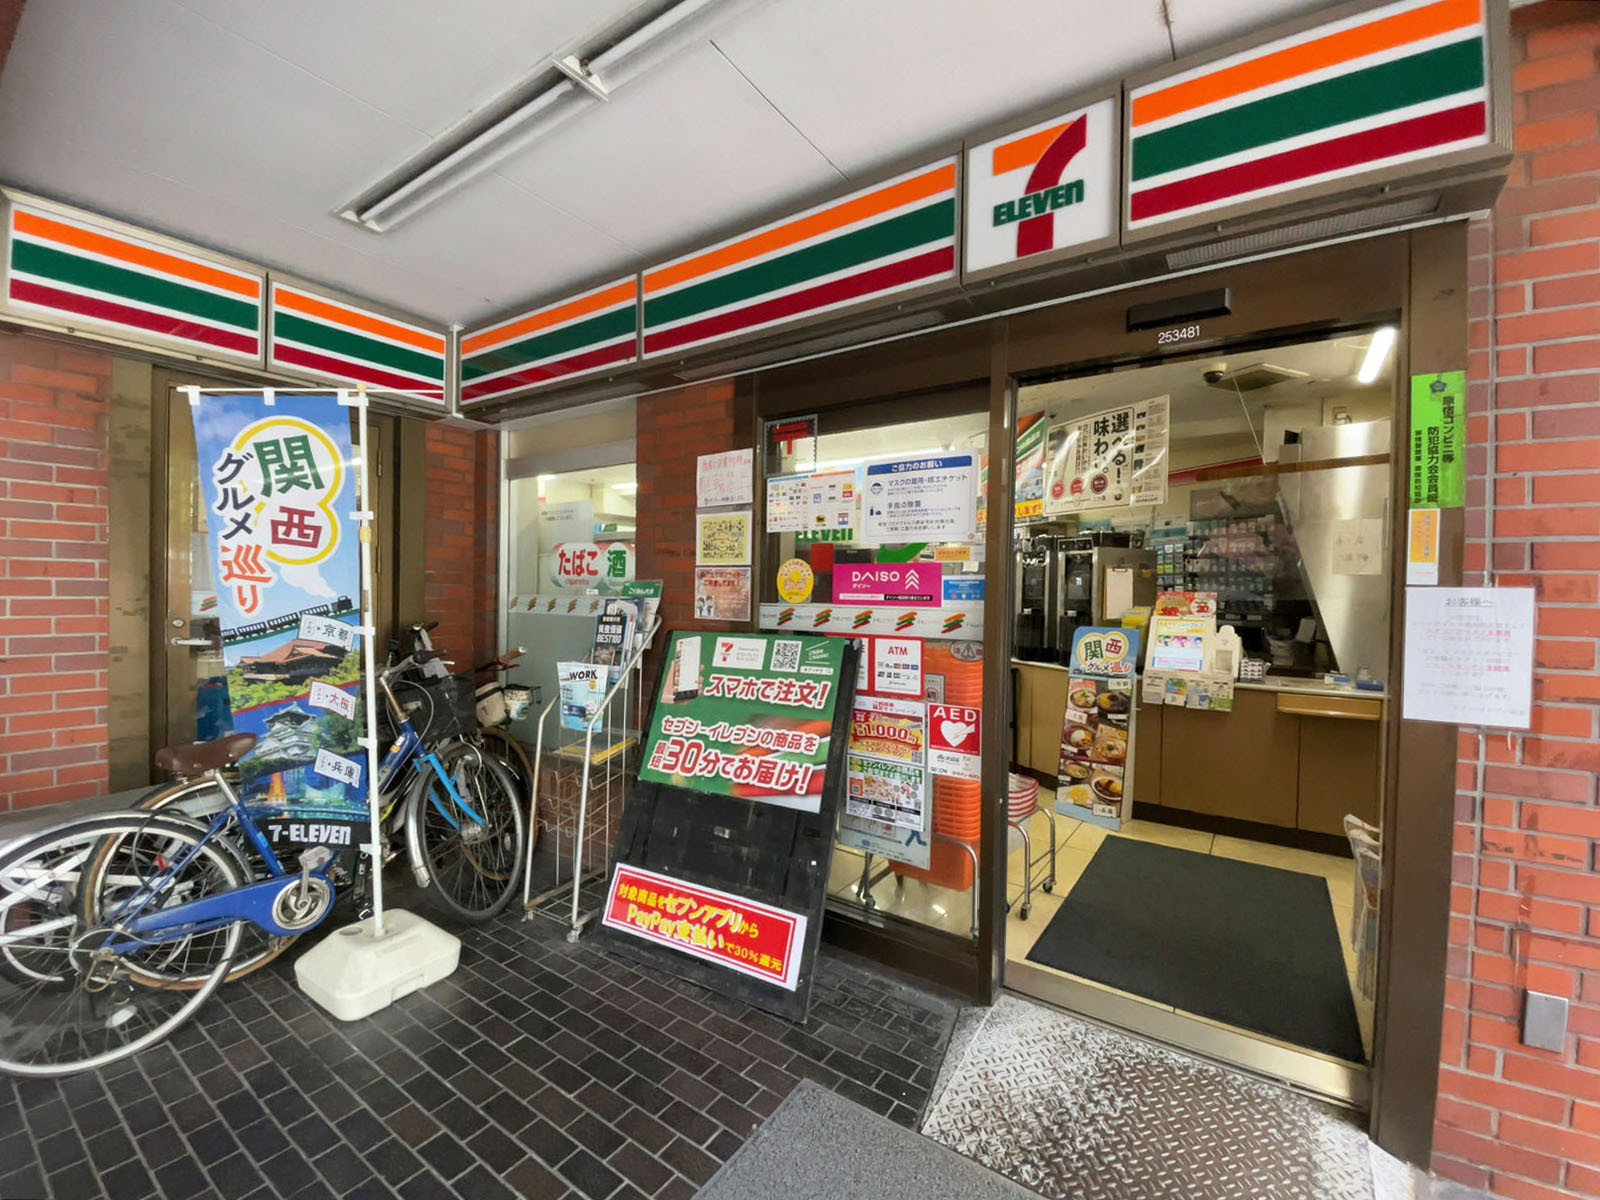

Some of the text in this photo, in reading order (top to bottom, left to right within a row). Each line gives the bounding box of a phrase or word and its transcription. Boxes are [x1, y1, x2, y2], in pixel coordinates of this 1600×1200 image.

[1158, 325, 1201, 345] 253481
[253, 435, 325, 549] 関西
[217, 452, 273, 614] グルメ巡り
[558, 548, 599, 577] たばこ
[607, 549, 627, 578] 酒
[852, 571, 900, 582] DAISO
[888, 646, 908, 655] ATM
[1084, 639, 1122, 662] 関西
[569, 670, 598, 681] WORK
[705, 676, 830, 707] スマホで注文!
[933, 706, 977, 722] AED
[617, 883, 760, 939] 対象商品をセブンアプリから
[626, 903, 784, 972] PayPay支払いで30%還元
